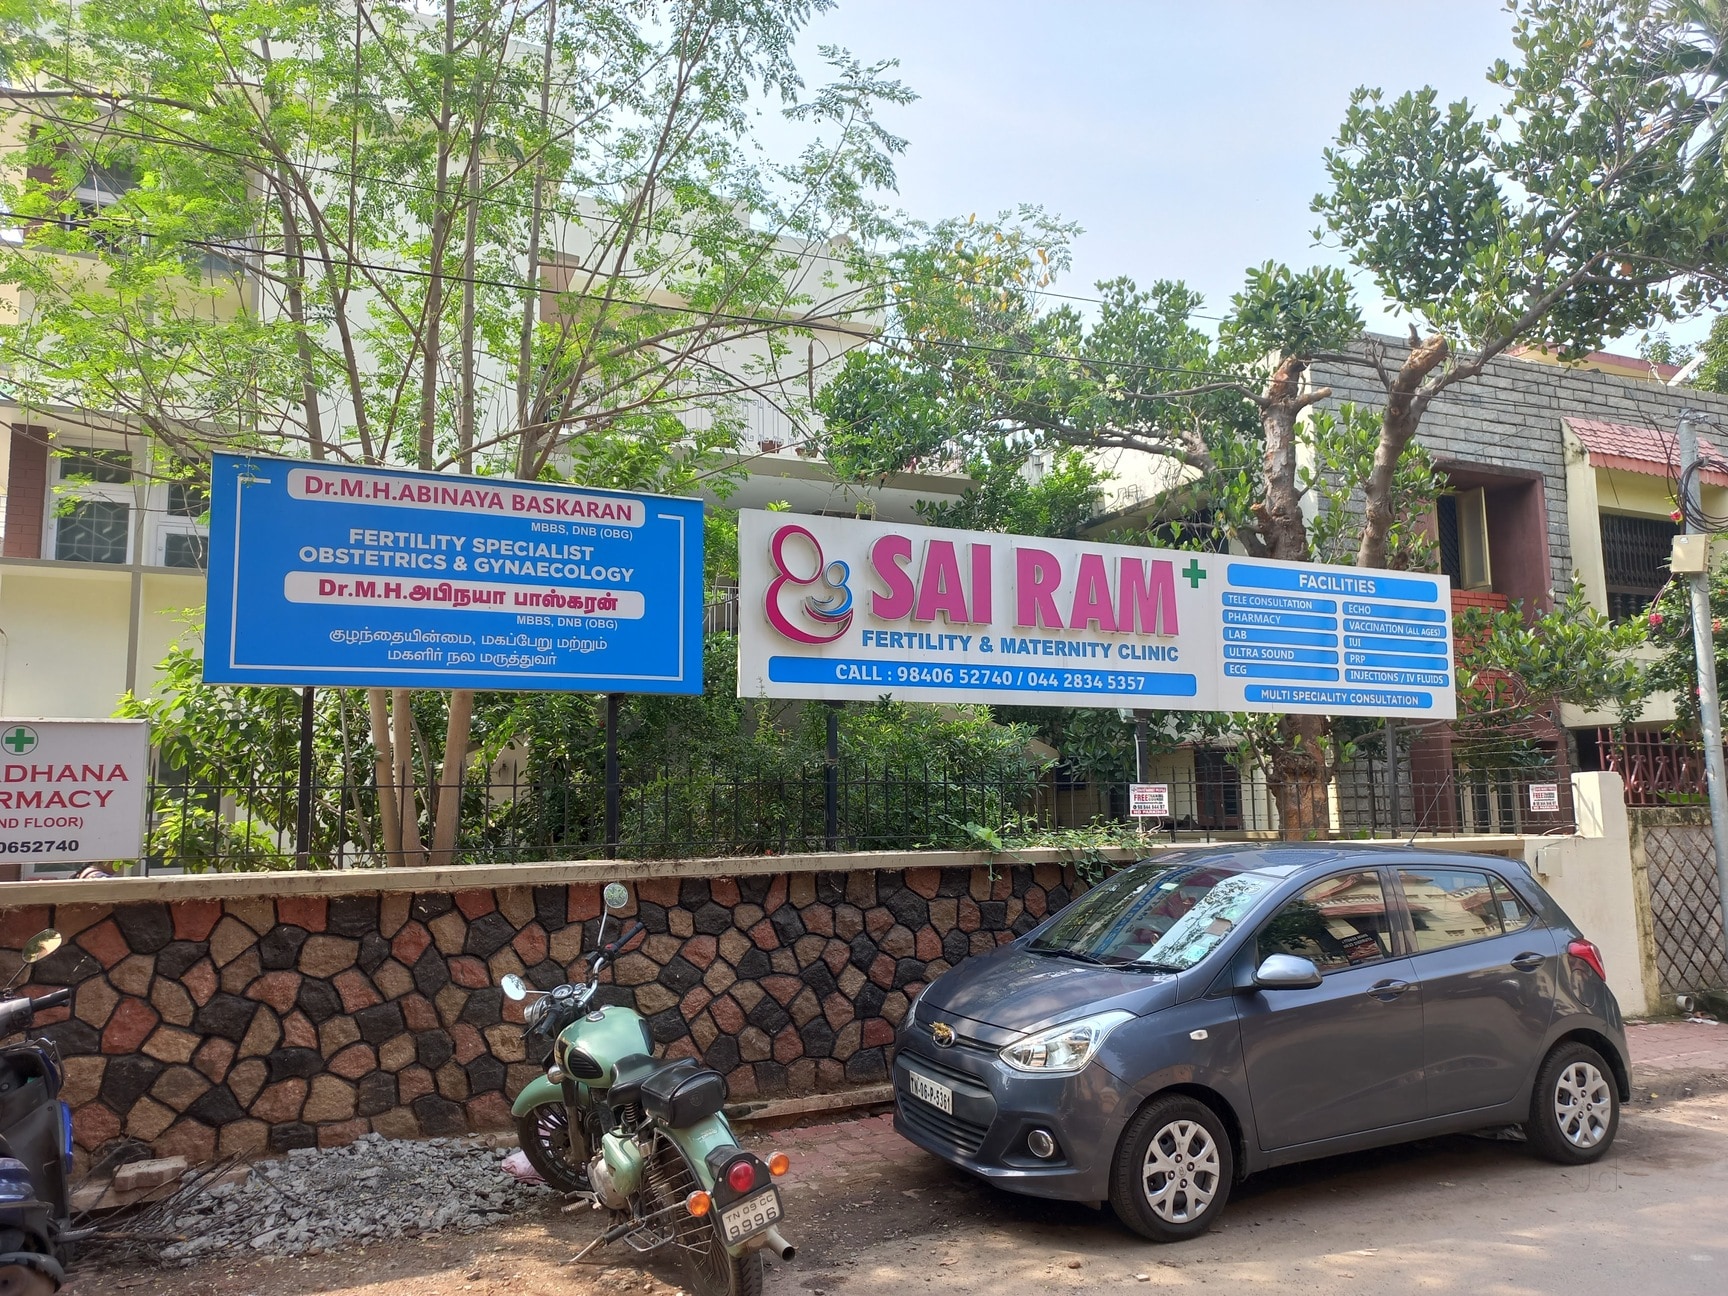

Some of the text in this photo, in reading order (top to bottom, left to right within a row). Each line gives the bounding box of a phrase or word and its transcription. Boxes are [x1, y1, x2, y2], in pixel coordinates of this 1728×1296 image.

[304, 475, 632, 522] Dr.M.H.ABINAYA BASKARAN
[531, 522, 633, 542] MBBS, DNB (OBG)
[349, 528, 594, 562] FERTILITY SPECIALIST
[299, 546, 635, 583] OBSTETRICS & GYNAECOLOGY
[868, 534, 1180, 638] SAI RAM
[1299, 574, 1376, 594] FACILITIES
[318, 579, 619, 614] Dr.M.H.அபிநயா பாஸ்கரன்
[1228, 595, 1313, 610] TELE CONSULTATION
[1228, 612, 1281, 625] PHARMACY
[1348, 604, 1371, 615] ECHO
[516, 615, 618, 631] MBBS, DNB (OBG)
[1349, 621, 1441, 637] VACCINATION (ALL AGES)
[329, 626, 608, 654] குழந்தையின்மை, மகப்பேறு மற்றும்
[1228, 629, 1247, 640] LAB
[1349, 637, 1361, 647] IUI
[861, 630, 1180, 662] FERTILITY & MATERNITY CLINIC
[1229, 647, 1295, 660] ULTRA SOUND
[387, 647, 558, 669] மகளிர் நல மருத்துவர்
[1350, 654, 1366, 664] PRP
[835, 664, 883, 682] CALL
[898, 666, 954, 685] 98406
[959, 669, 1013, 687] 52740
[1016, 671, 1023, 688] /
[1027, 671, 1059, 688] 044
[1063, 673, 1103, 690] 2834
[1107, 674, 1146, 691] 5357
[1229, 664, 1247, 675] ECG
[1350, 671, 1399, 683] INJECTIONS
[1406, 673, 1415, 683] IV
[1416, 674, 1444, 685] FLUIDS
[1261, 688, 1419, 705] MULTI SPECIALITY CONSULTATION
[0, 764, 129, 783] DHANA
[24, 817, 84, 829] FLOOR)
[726, 1211, 740, 1222] TN
[742, 1202, 757, 1215] 09
[730, 1207, 776, 1238] 9996
